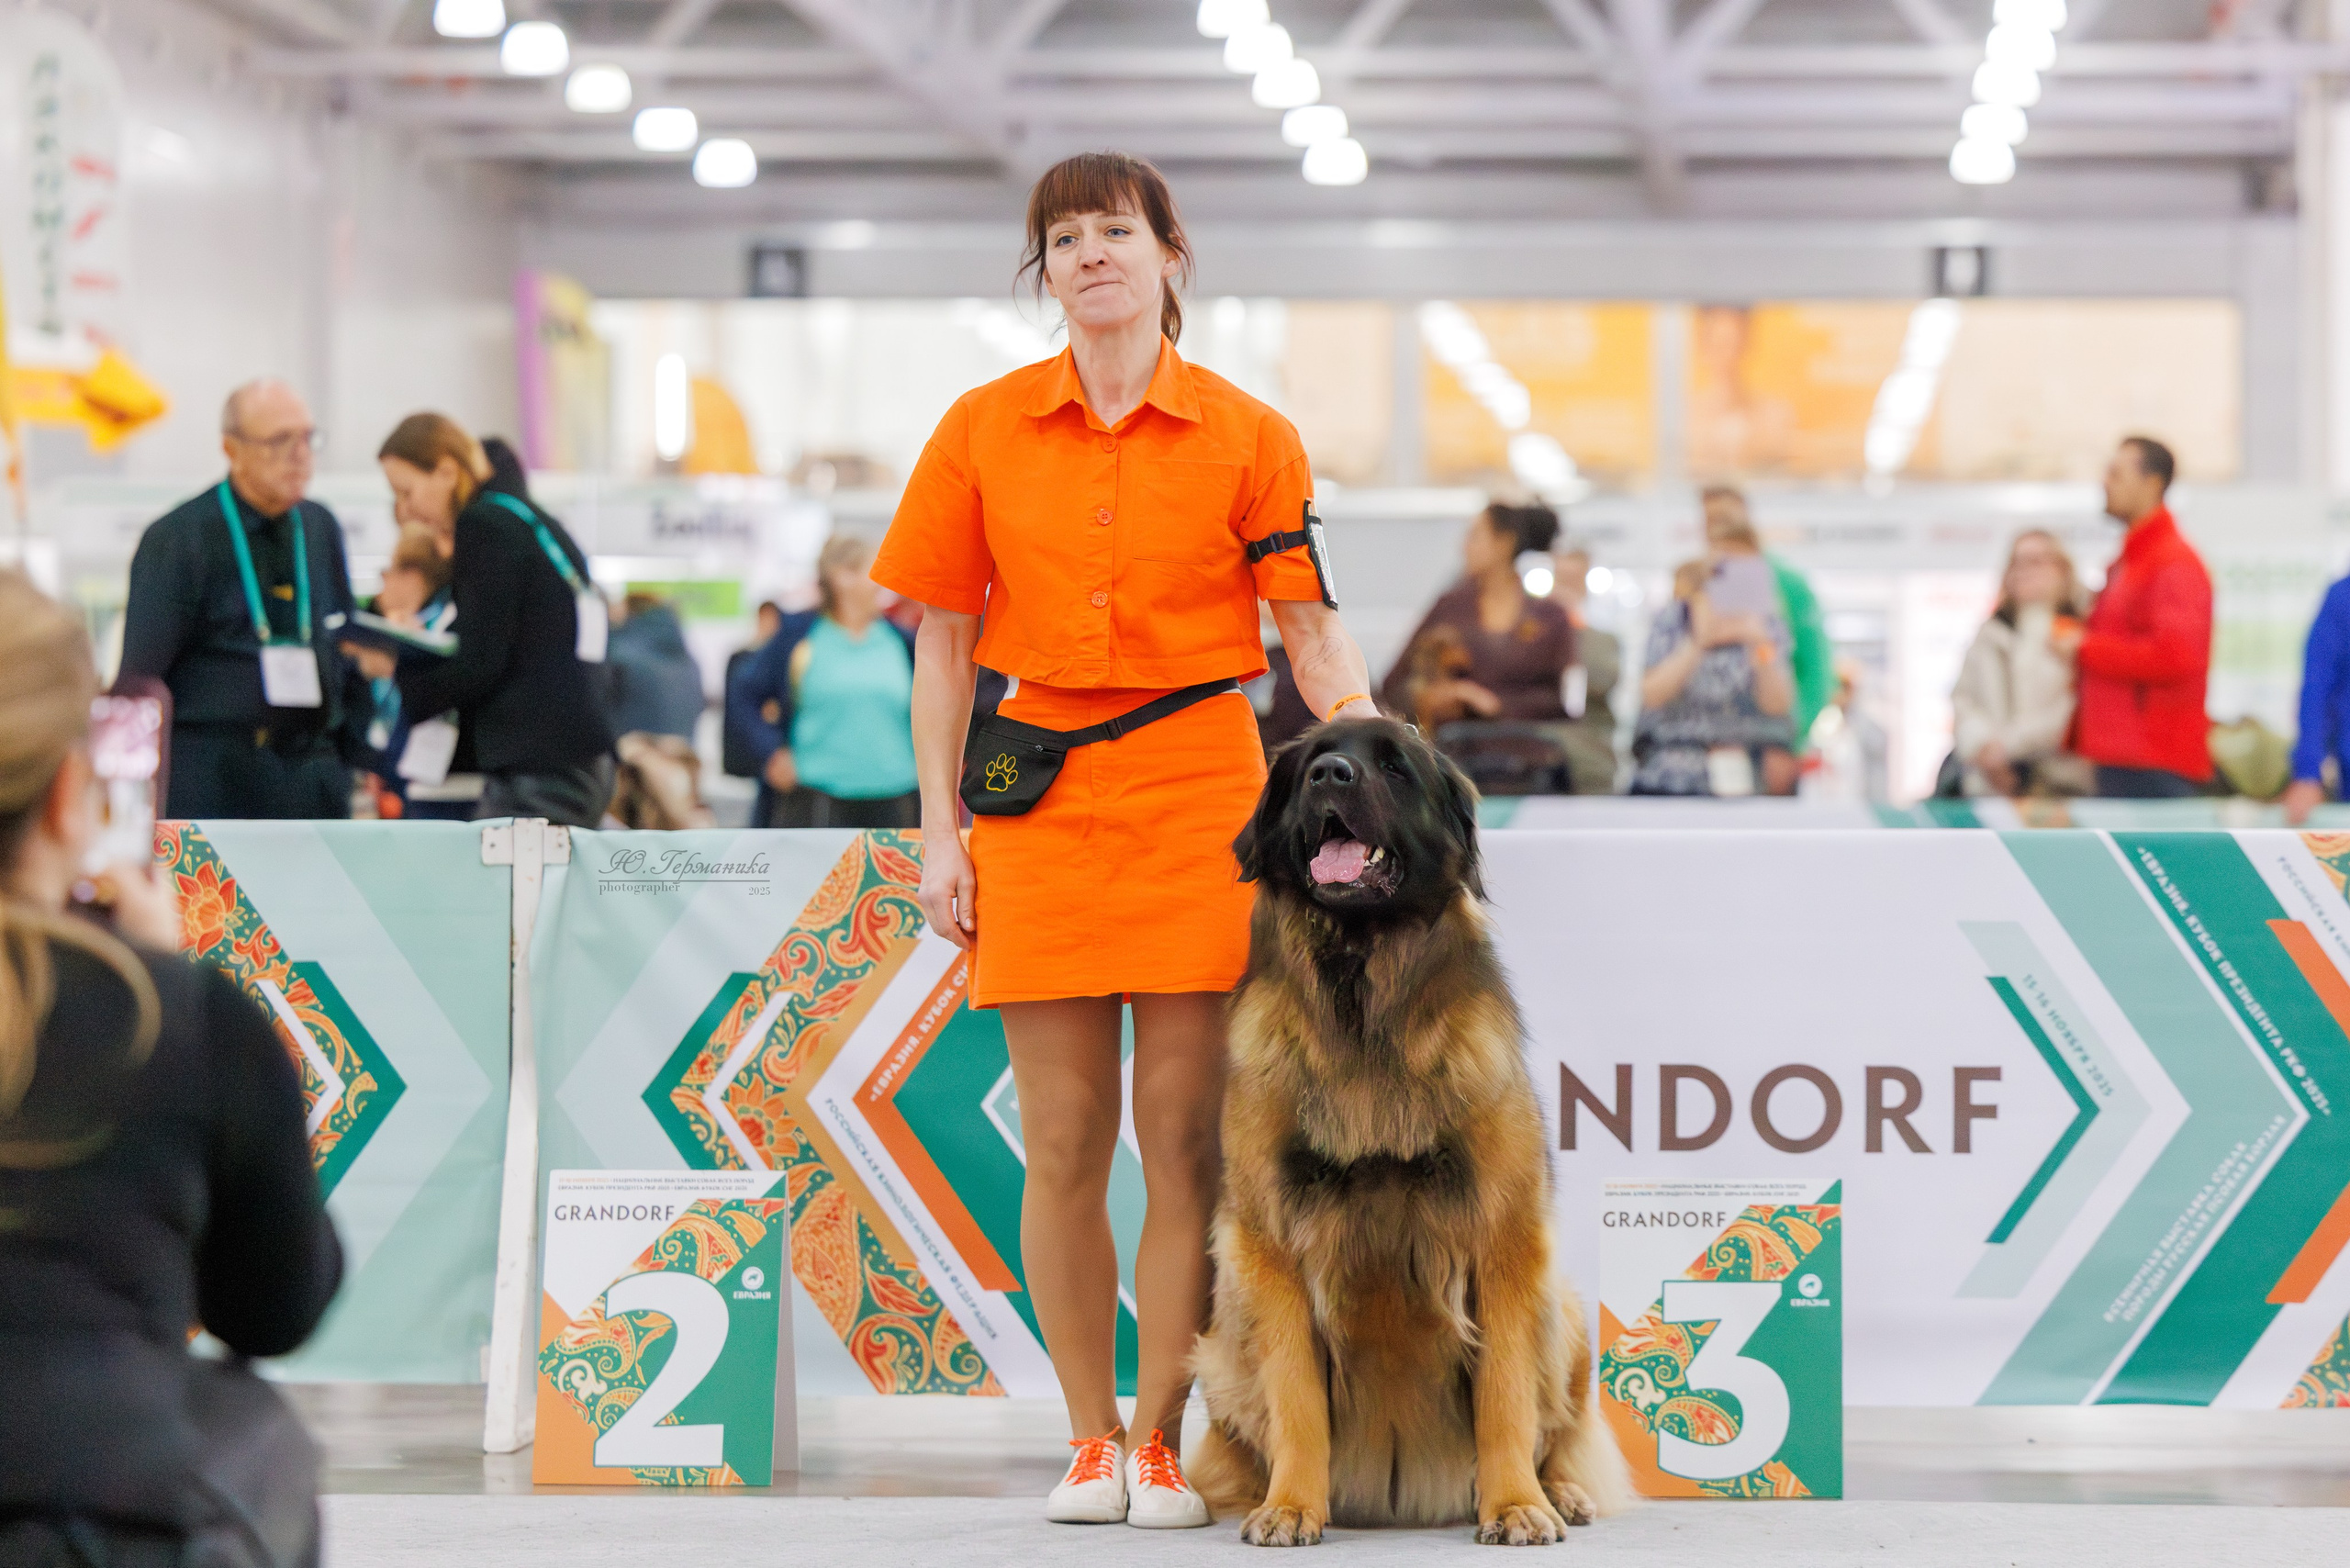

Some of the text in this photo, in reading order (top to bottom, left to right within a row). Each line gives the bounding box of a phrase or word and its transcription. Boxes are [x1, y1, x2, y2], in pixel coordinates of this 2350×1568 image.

[918, 987, 957, 1034] КУБОК
[2185, 914, 2223, 962] КУБОК
[2218, 960, 2284, 1049] ПРЕЗИДЕНТА
[2279, 1047, 2307, 1078] РКФ
[1559, 1060, 2003, 1154] NDORF
[554, 1204, 675, 1221] GRANDORF
[1603, 1211, 1727, 1227] GRANDORF
[733, 1291, 771, 1299] ЕВРАЗИЯ
[594, 1271, 730, 1467] 2
[1658, 1282, 1789, 1480] 3
